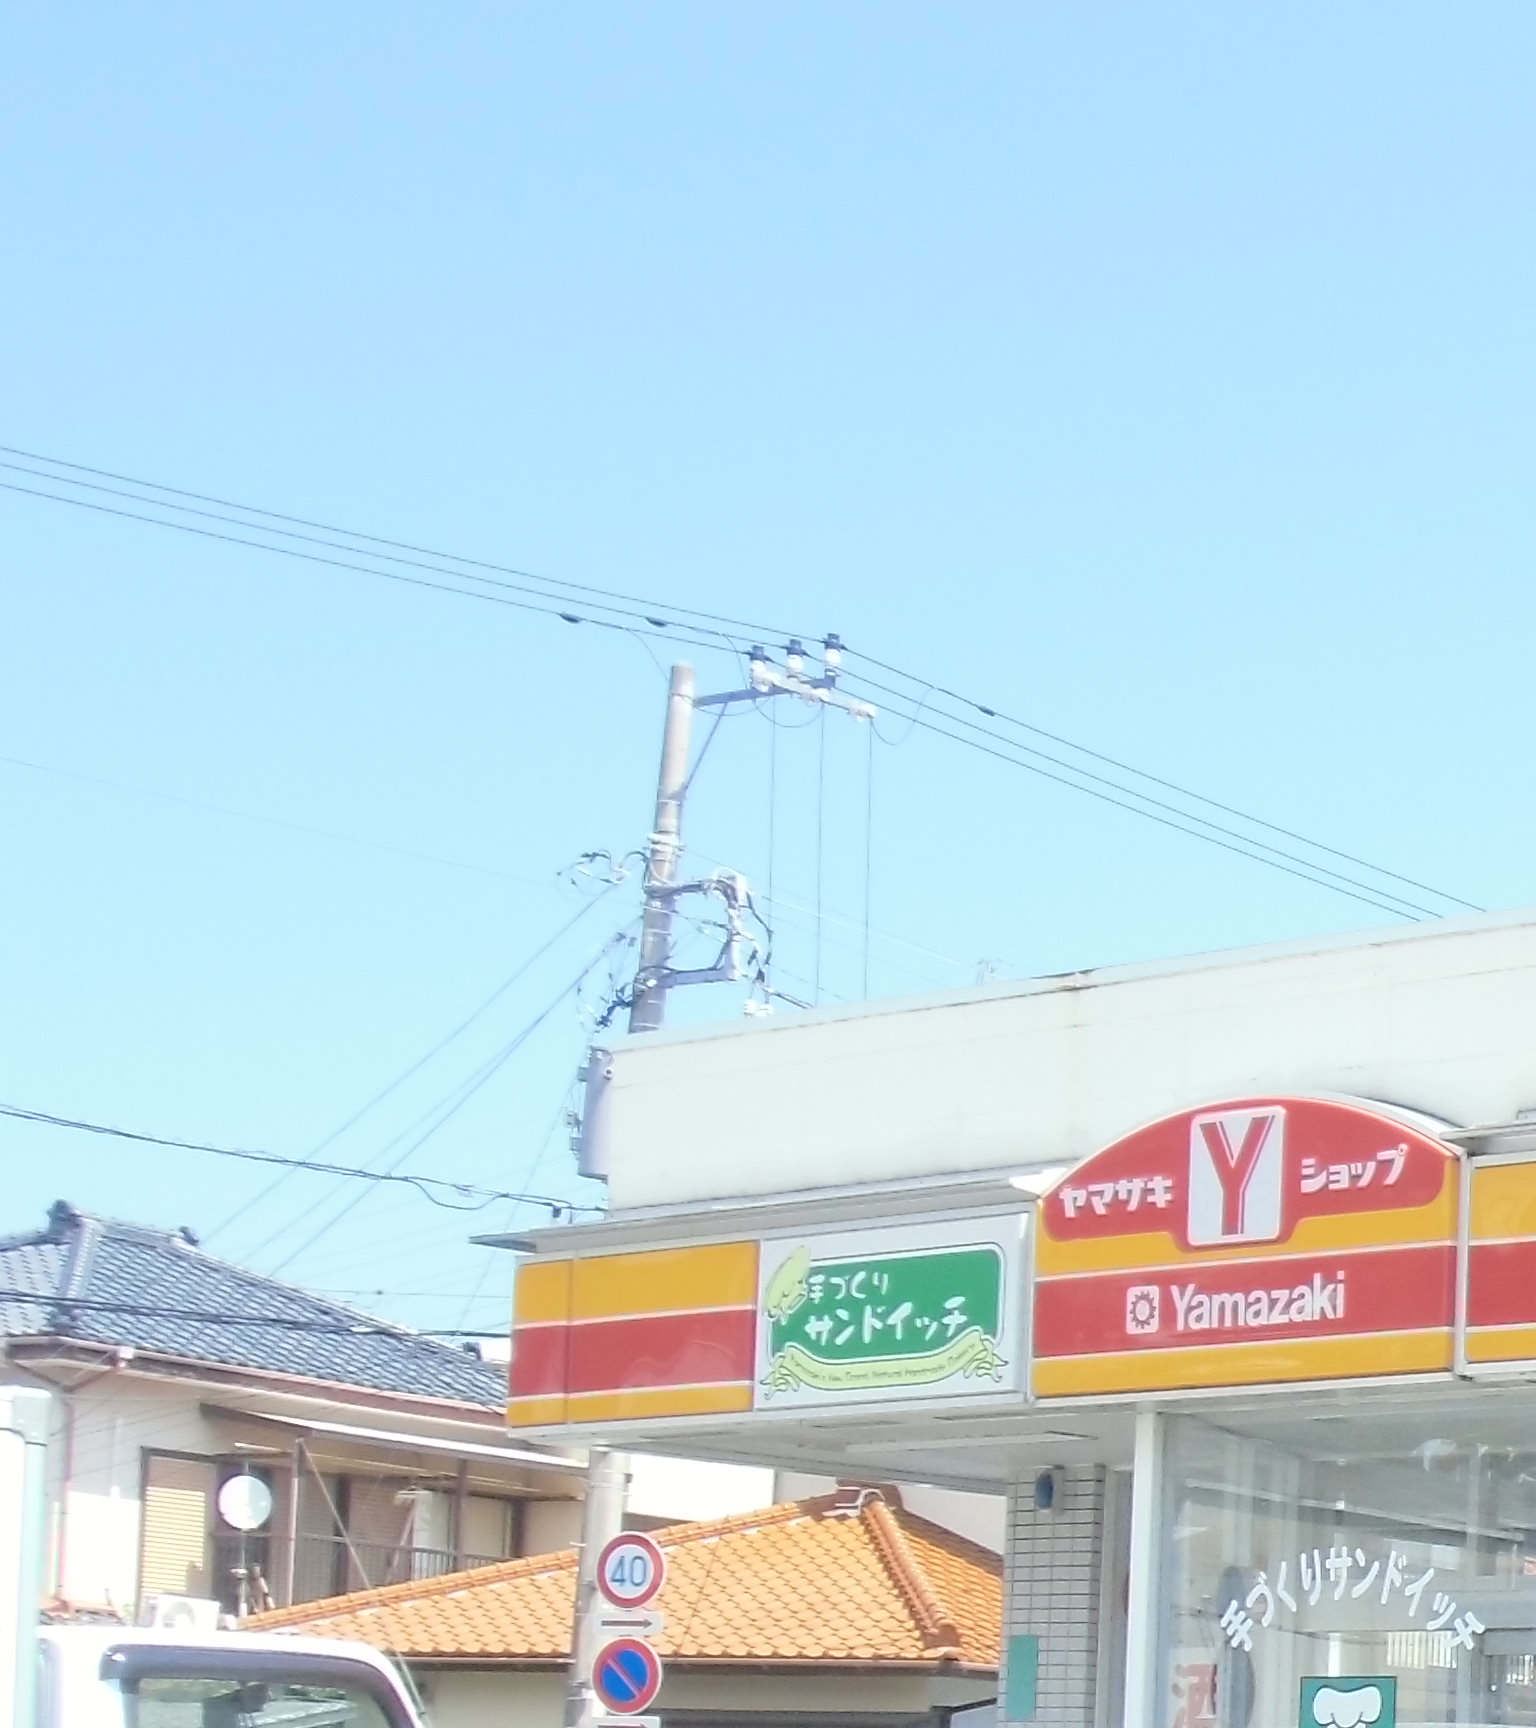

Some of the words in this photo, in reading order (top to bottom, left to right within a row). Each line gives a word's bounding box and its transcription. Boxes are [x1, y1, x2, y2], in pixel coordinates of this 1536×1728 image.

[1199, 1114, 1276, 1236] Y
[1300, 1143, 1410, 1194] ショップ
[1058, 1175, 1174, 1219] ヤマザキ
[808, 1271, 889, 1304] 手づくり
[1170, 1270, 1346, 1332] Yamazaki
[804, 1296, 968, 1346] サンドイッチ
[610, 1555, 647, 1587] 40
[1220, 1545, 1485, 1652] 手づくりサンドイッチ
